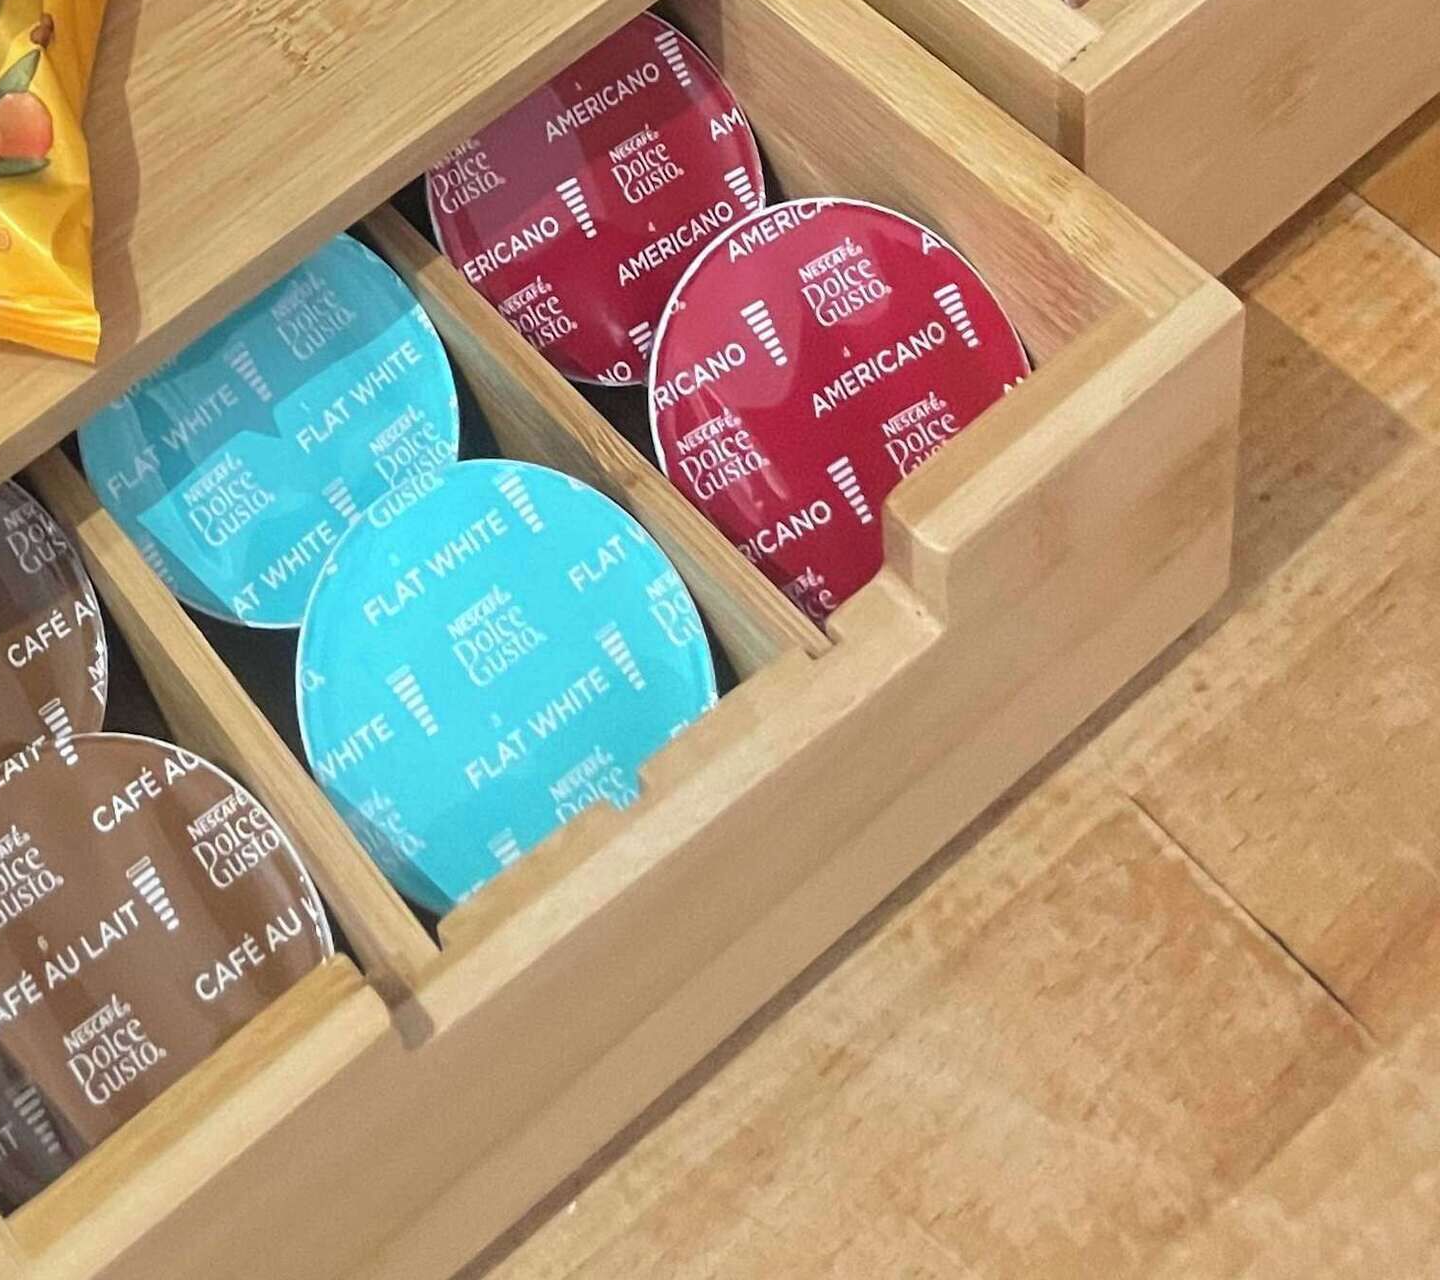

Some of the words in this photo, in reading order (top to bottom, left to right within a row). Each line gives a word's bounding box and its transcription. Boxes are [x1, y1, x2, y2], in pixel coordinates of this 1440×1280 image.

[545, 62, 660, 144] AMERICANO
[608, 123, 653, 164] NESCAFÉ
[610, 143, 669, 190] Dolce
[624, 162, 679, 204] Gusto
[463, 216, 559, 283] ERICANO
[618, 201, 733, 287] AMERICANO
[798, 236, 859, 283] NESCAFÉ
[513, 295, 563, 335] olce
[801, 259, 876, 310] Dolce
[815, 279, 885, 327] Gusto
[528, 315, 572, 349] usto
[296, 396, 352, 454] FLAT
[349, 340, 422, 407] WHITE
[654, 343, 746, 411] RICANO
[811, 321, 947, 419] AMERICANO
[107, 444, 161, 505] FLAT
[162, 383, 240, 452] WHITE
[676, 406, 735, 455] NESCAFÉ
[881, 391, 941, 438] NESCAFÉ
[884, 413, 961, 466] Dolce
[678, 429, 753, 483] Dolce
[693, 450, 760, 501] Gusto
[738, 500, 832, 563] RICANO
[231, 582, 261, 620] AT
[261, 520, 338, 590] WHITE
[363, 566, 426, 627] FLAT
[426, 507, 508, 578] WHITE
[567, 534, 627, 593] FLAT
[8, 609, 72, 668] CAFÉ
[465, 728, 527, 791] FLAT
[528, 666, 610, 739] WHITE
[92, 766, 162, 833] CAFÉ
[192, 807, 268, 870] Dolce
[210, 831, 280, 889] Gusto
[45, 945, 80, 989] AU
[80, 899, 140, 959] LAIT
[195, 933, 266, 1001] CAFÉ
[266, 907, 302, 953] AU
[68, 1019, 146, 1085] Dolce
[85, 1041, 159, 1105] Gusto
